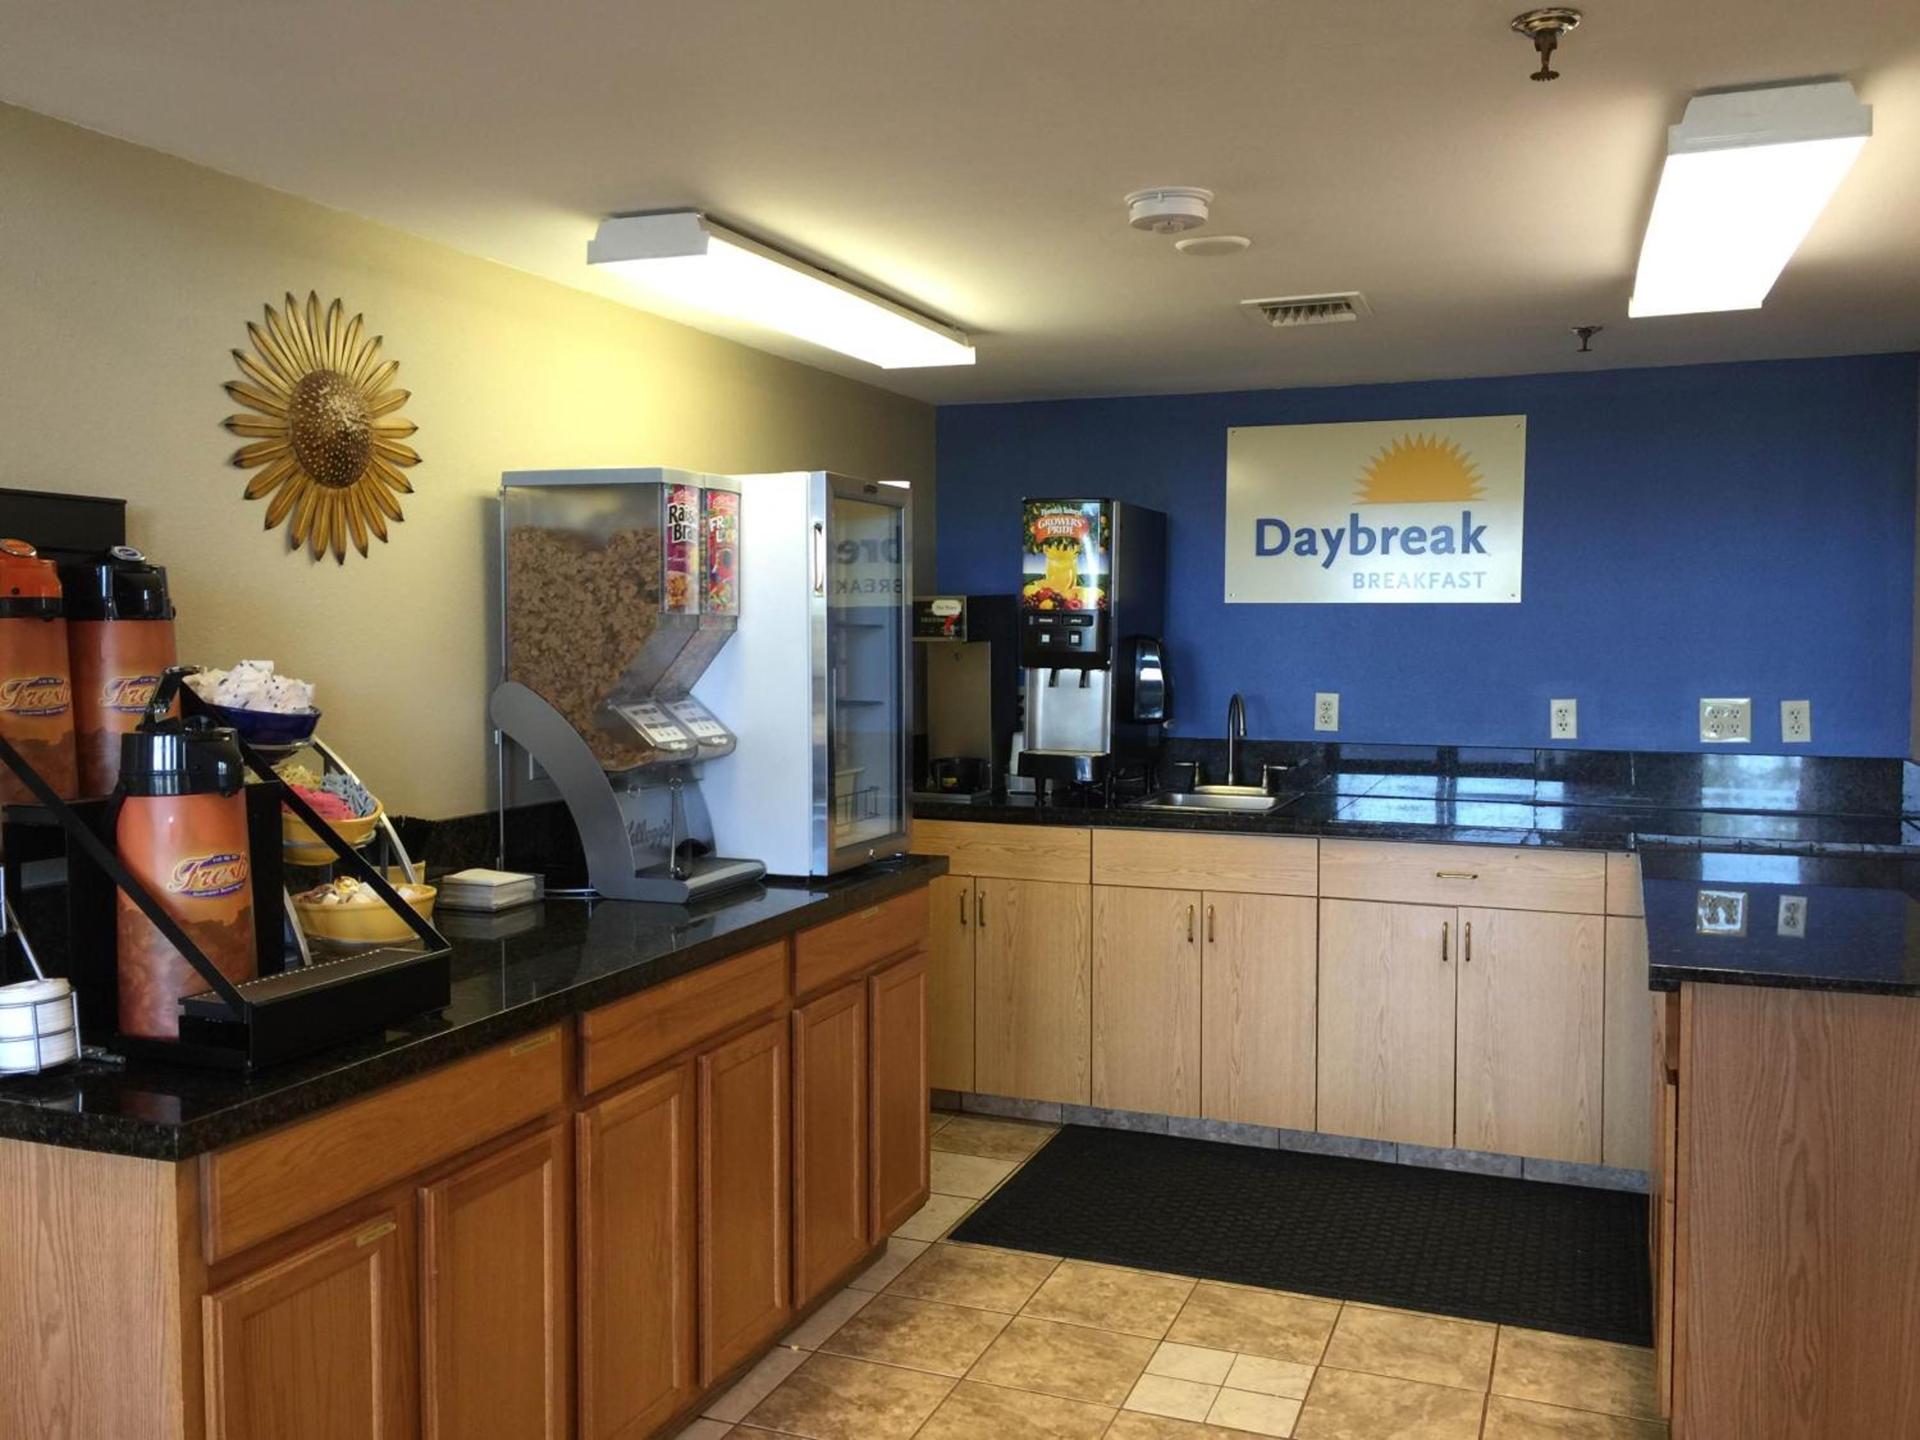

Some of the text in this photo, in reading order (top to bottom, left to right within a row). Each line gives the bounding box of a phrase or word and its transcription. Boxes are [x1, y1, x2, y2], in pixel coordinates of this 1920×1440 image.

[668, 502, 696, 524] Rais
[673, 523, 696, 542] Bra
[1047, 525, 1074, 536] PRIDE
[1255, 510, 1487, 570] Daybreak
[1352, 571, 1487, 589] BREAKFAST
[0, 677, 71, 711] Fresh
[100, 677, 154, 708] Fre
[165, 851, 248, 894] Fresh
